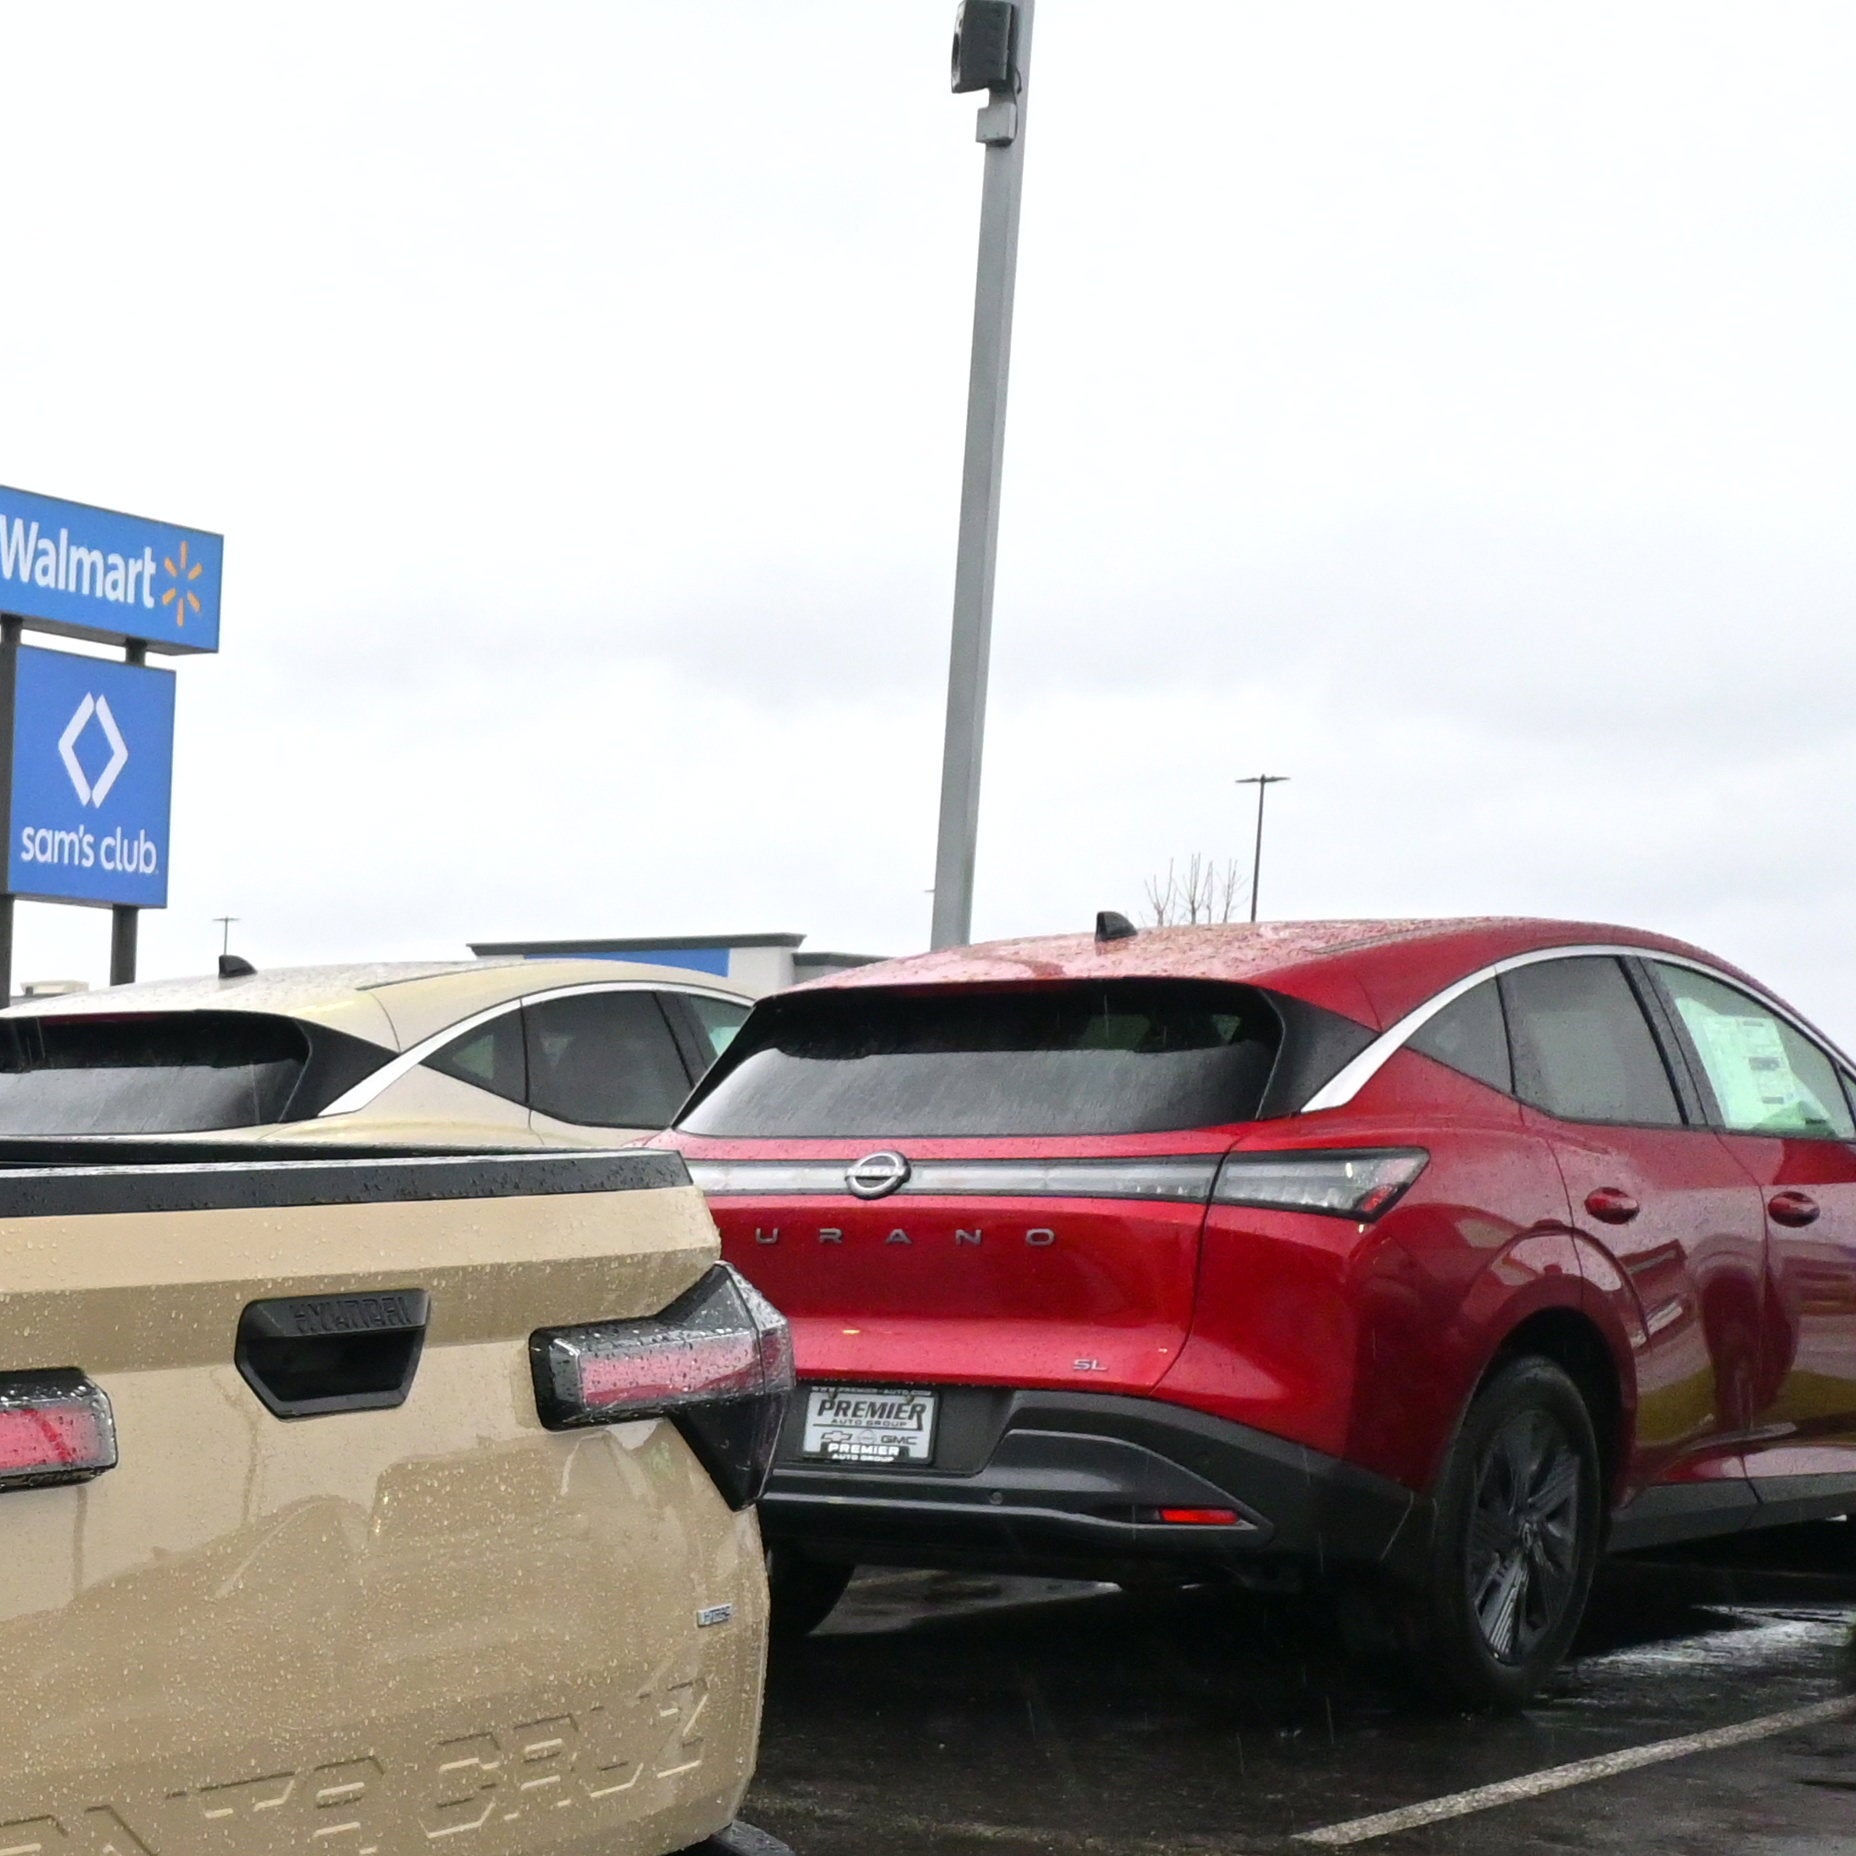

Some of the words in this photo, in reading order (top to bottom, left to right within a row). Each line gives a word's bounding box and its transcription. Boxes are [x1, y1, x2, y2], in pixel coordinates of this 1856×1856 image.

[21, 825, 94, 867] sam's
[99, 827, 157, 874] club
[755, 1228, 1055, 1246] URANO
[1073, 1358, 1107, 1371] SL
[817, 1399, 927, 1429] PREMIER
[880, 1434, 917, 1445] GMC
[828, 1443, 899, 1456] PREMIER
[421, 1678, 710, 1838] CRUZ
